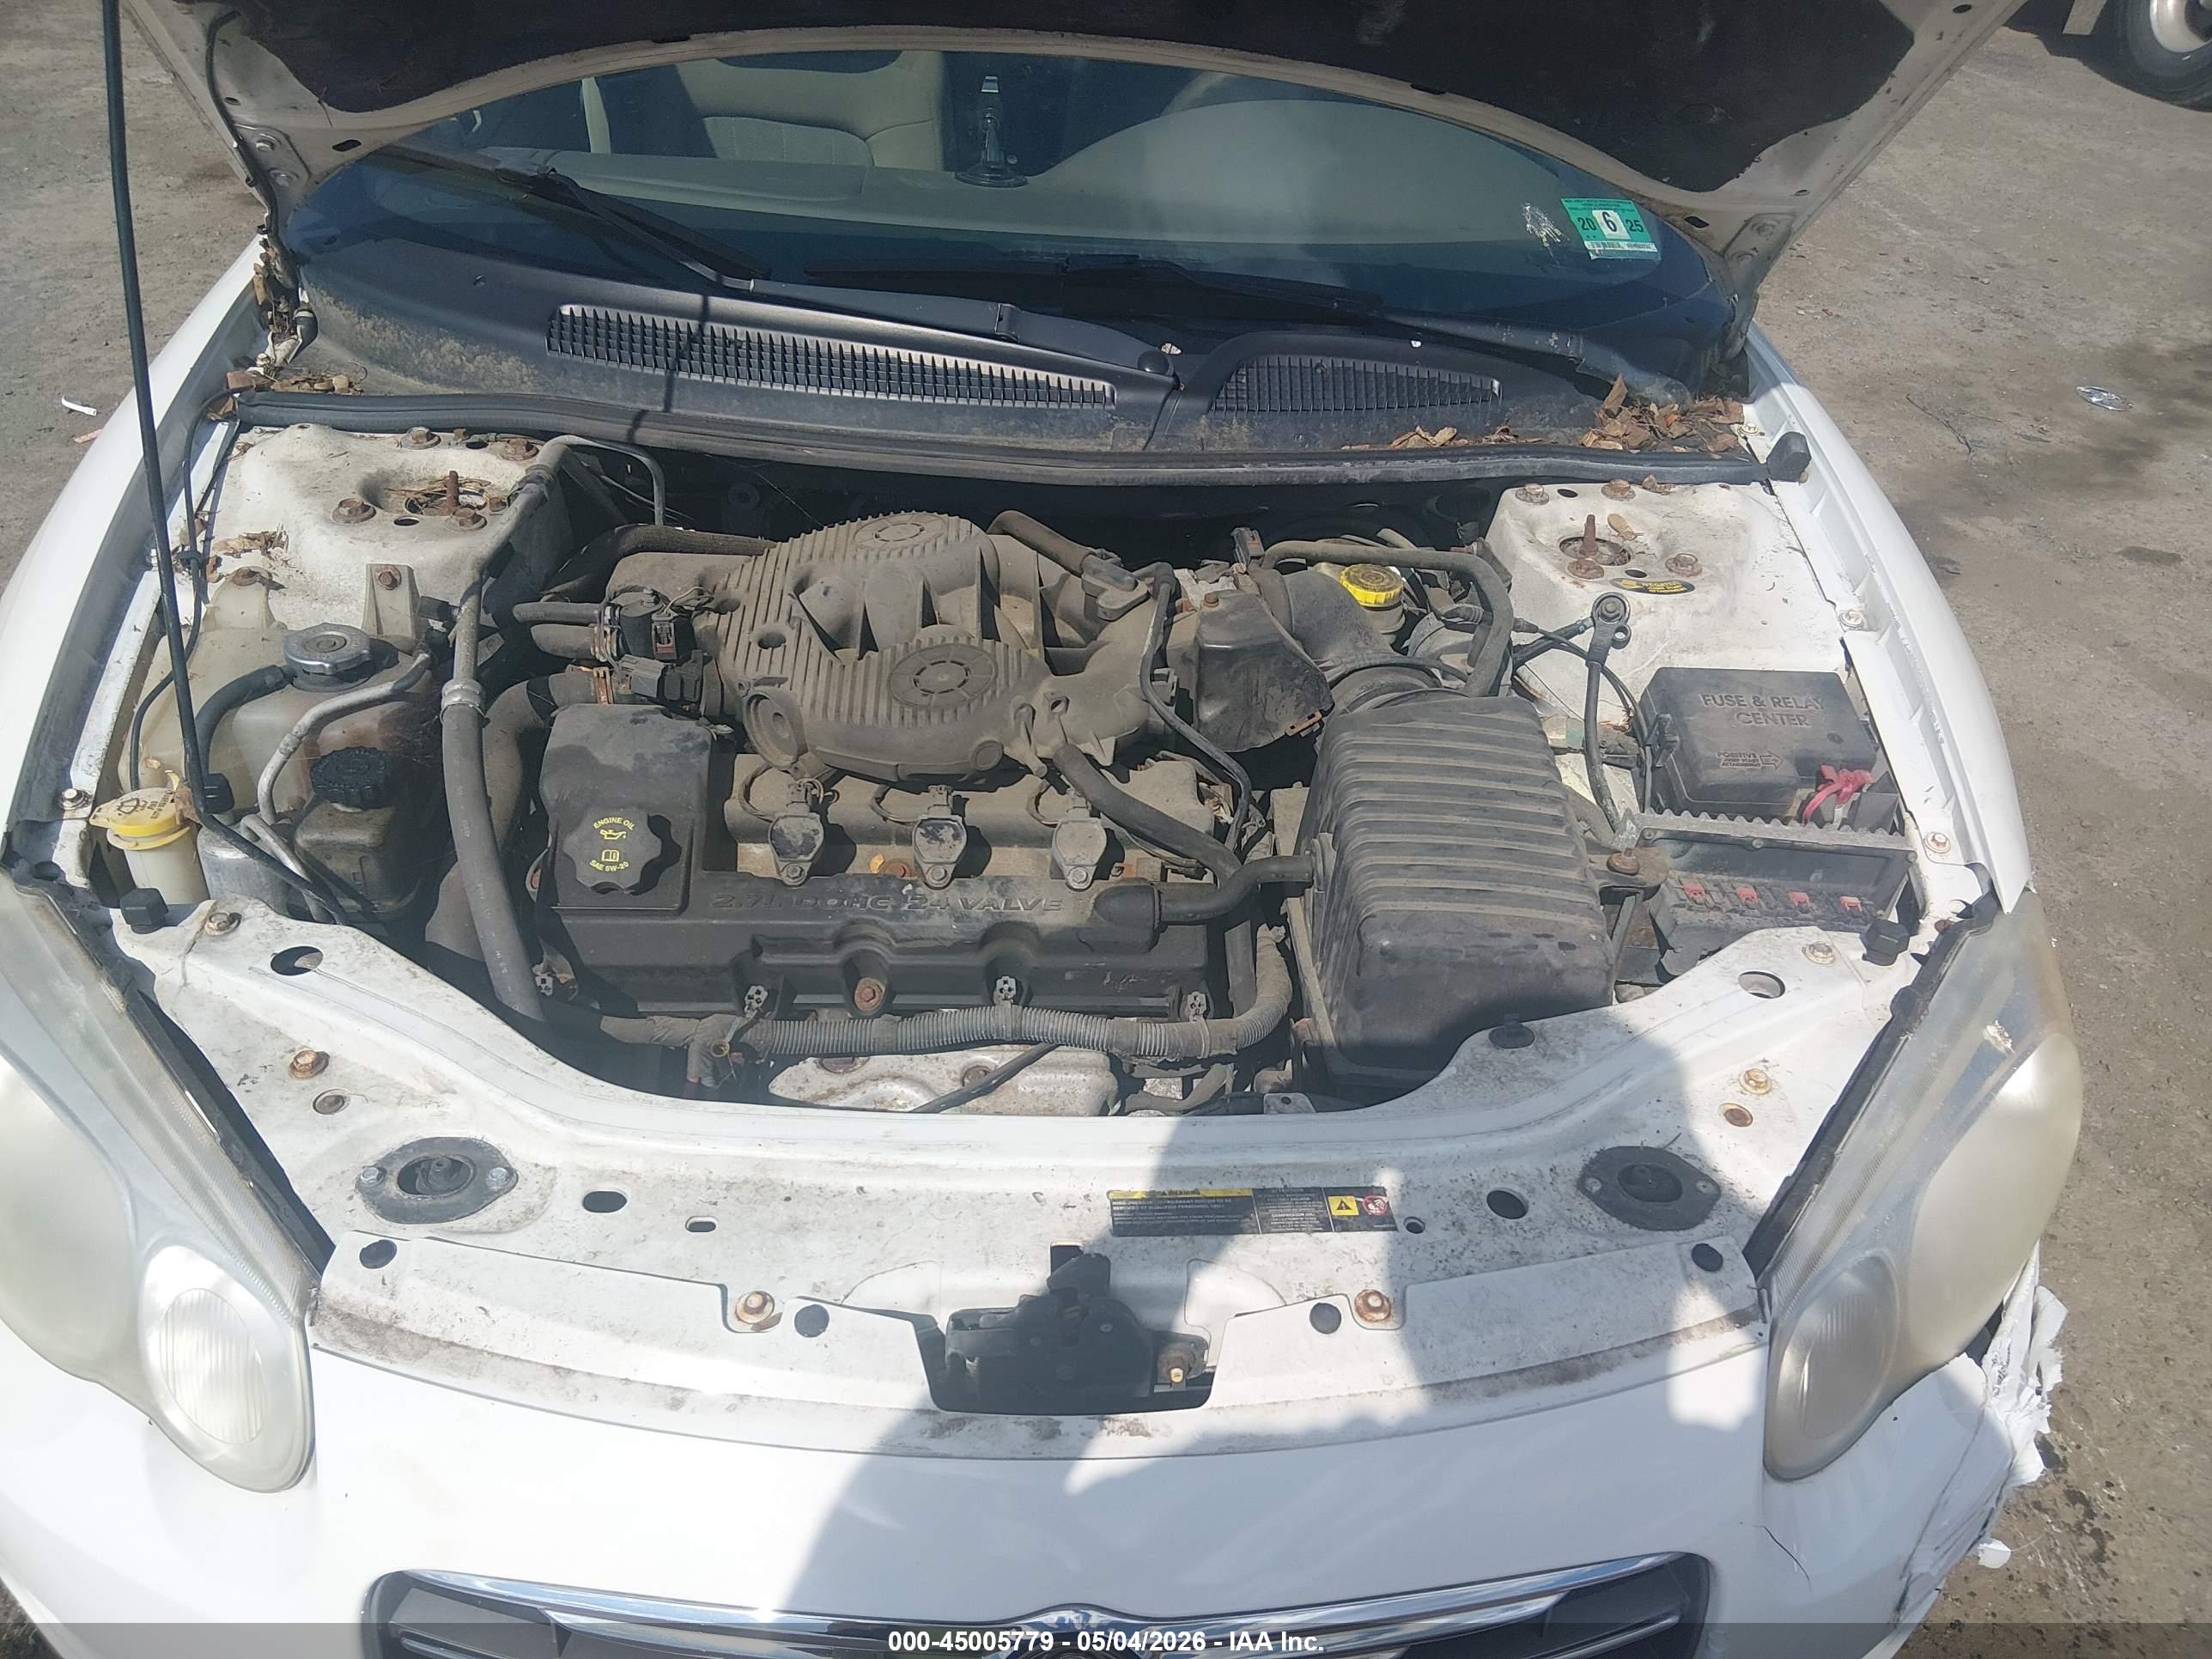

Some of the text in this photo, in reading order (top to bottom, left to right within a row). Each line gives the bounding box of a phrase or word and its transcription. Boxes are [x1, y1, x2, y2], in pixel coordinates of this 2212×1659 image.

[1577, 211, 1644, 233] 20 6 25
[1701, 694, 1826, 711] FUSE & RELAY
[1736, 712, 1809, 726] CENTER
[593, 817, 635, 831] ENGINE OIL
[590, 860, 605, 872] SAE
[712, 893, 1065, 911] 2.7L DOHC 24 VALVE
